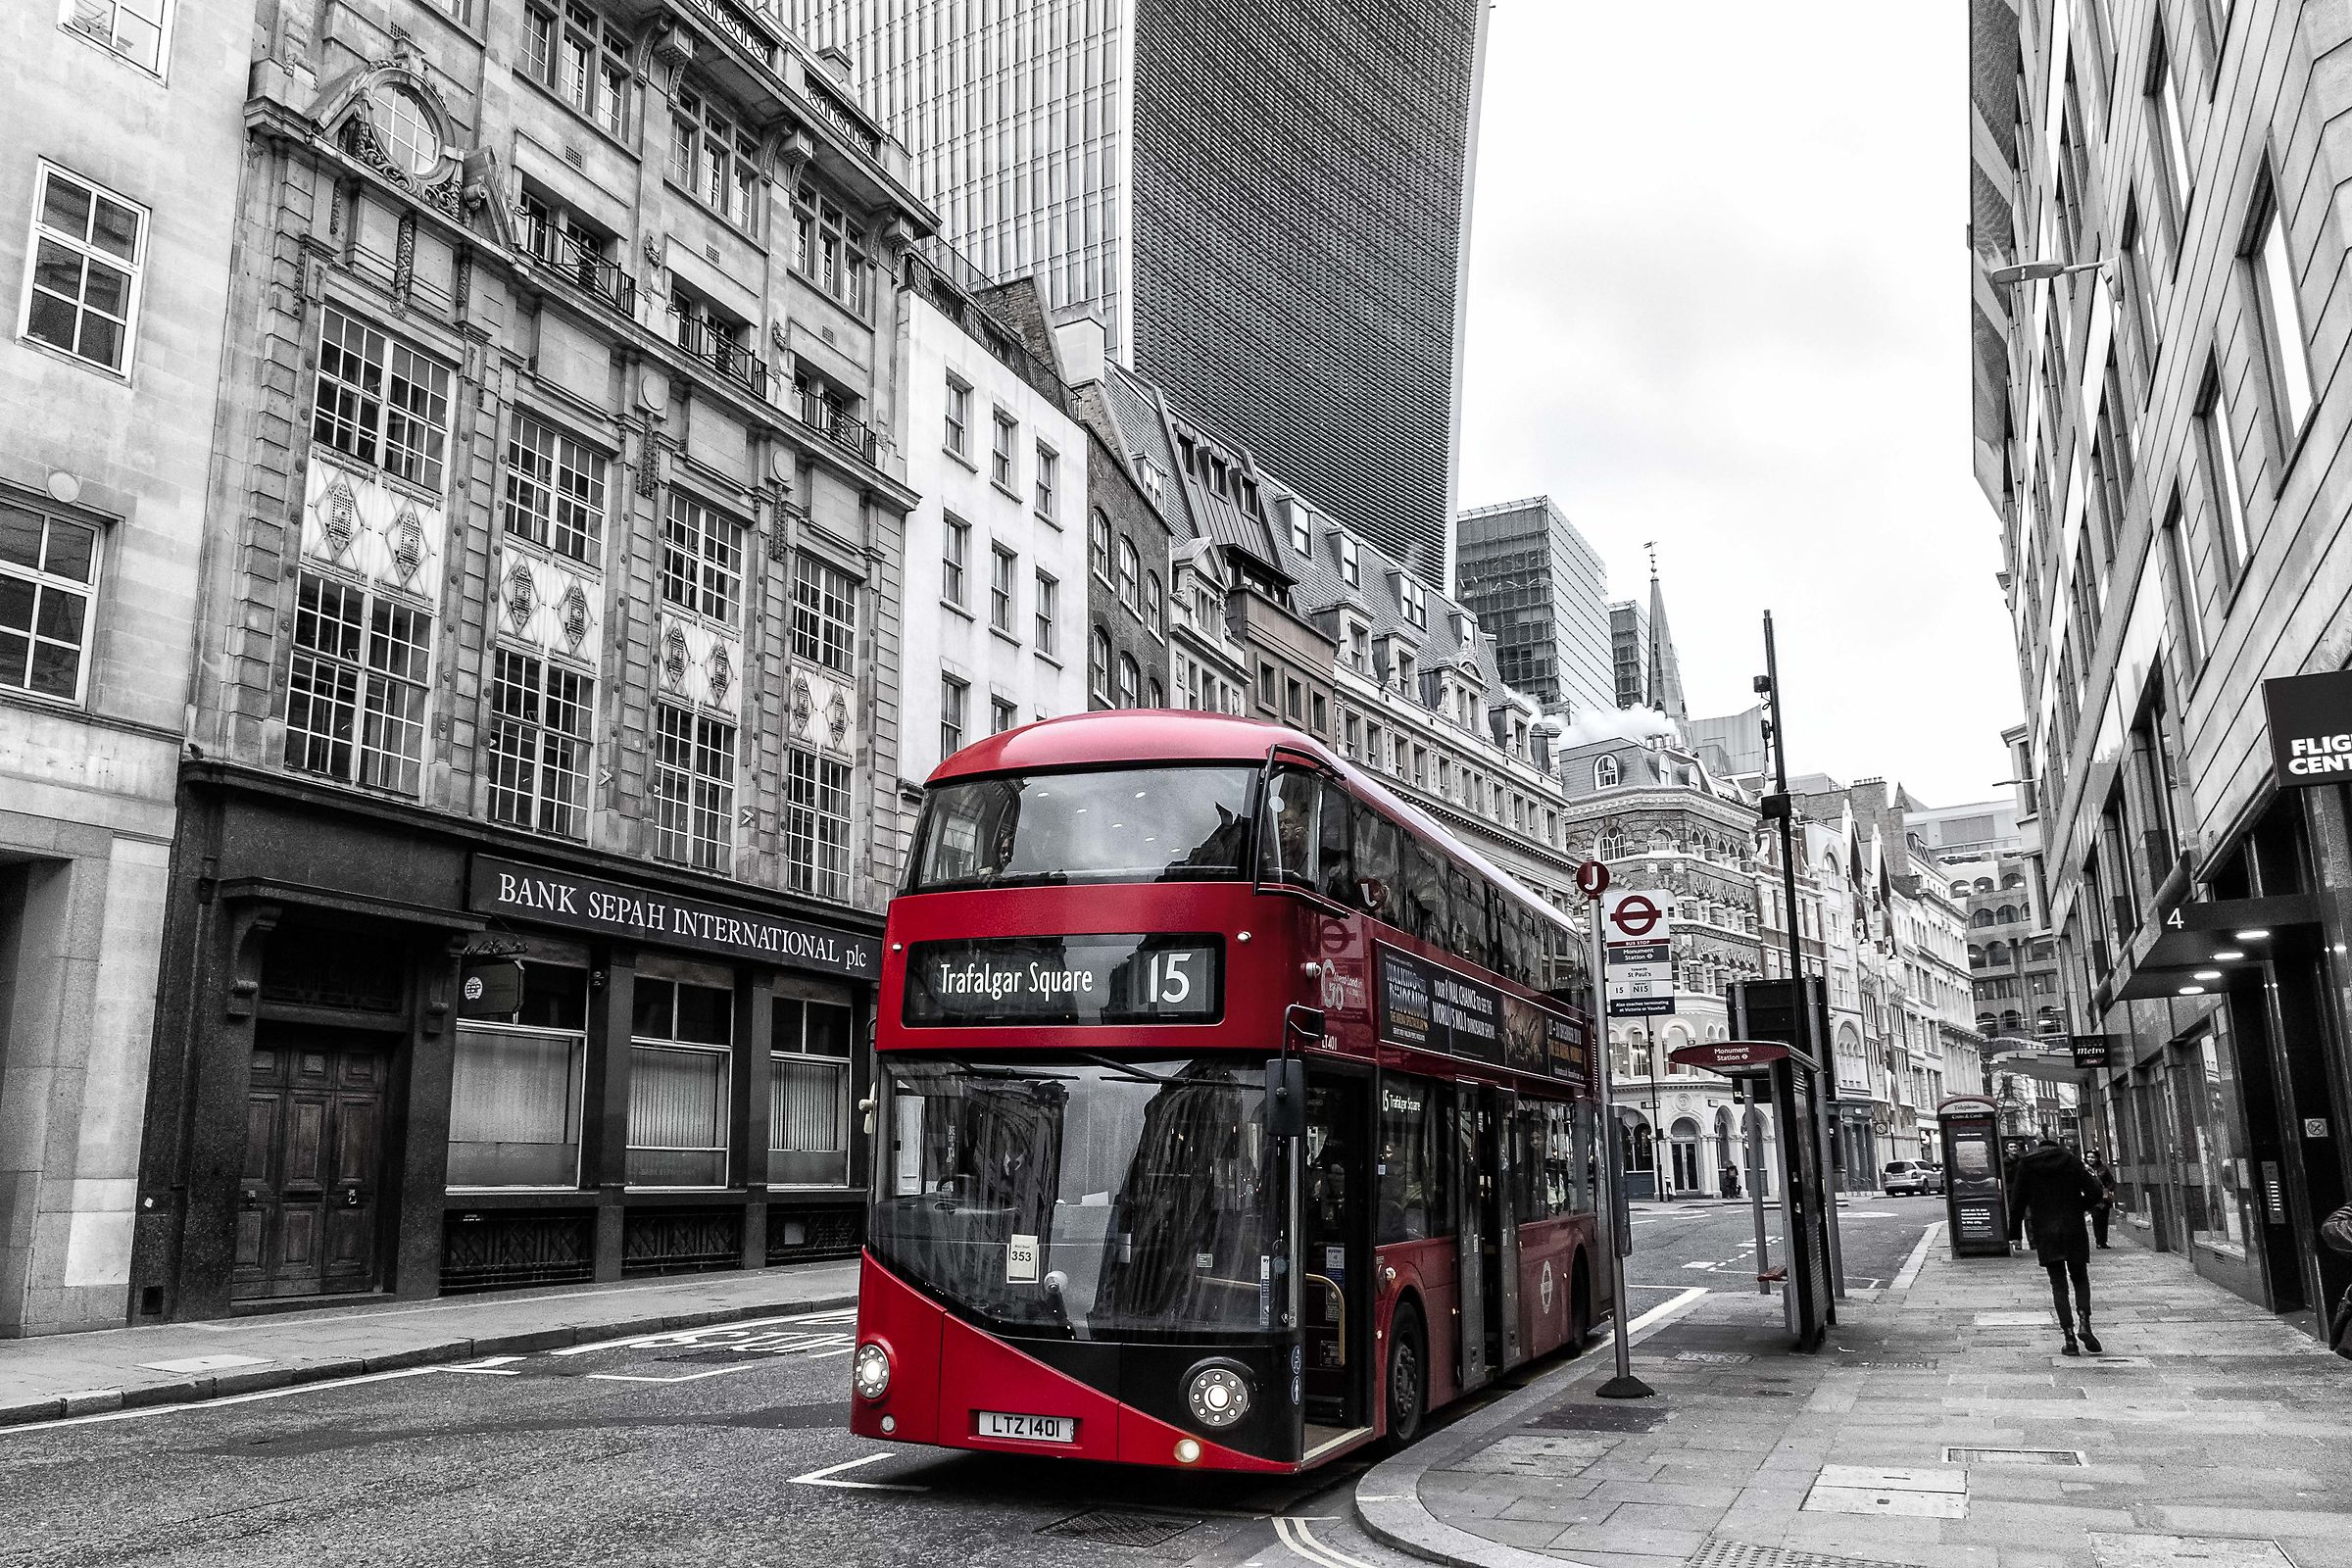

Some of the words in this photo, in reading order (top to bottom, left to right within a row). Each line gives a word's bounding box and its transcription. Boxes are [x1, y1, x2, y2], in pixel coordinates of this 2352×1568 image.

[2291, 734, 2352, 756] FLIG
[1584, 866, 1598, 890] J
[498, 873, 577, 914] BANK
[588, 891, 665, 931] SEPAH
[673, 908, 840, 962] INTERNATIONAL
[846, 944, 867, 970] plc
[2167, 908, 2184, 929] 4
[940, 962, 1023, 1001] Trafalgar
[1029, 961, 1093, 1002] Square
[1149, 953, 1192, 1004] 15
[1389, 1094, 1407, 1112] Trafalgar
[1408, 1097, 1421, 1113] Square
[1011, 1251, 1031, 1261] 353
[992, 1417, 1024, 1434] LTZ
[1029, 1418, 1060, 1438] 1401
